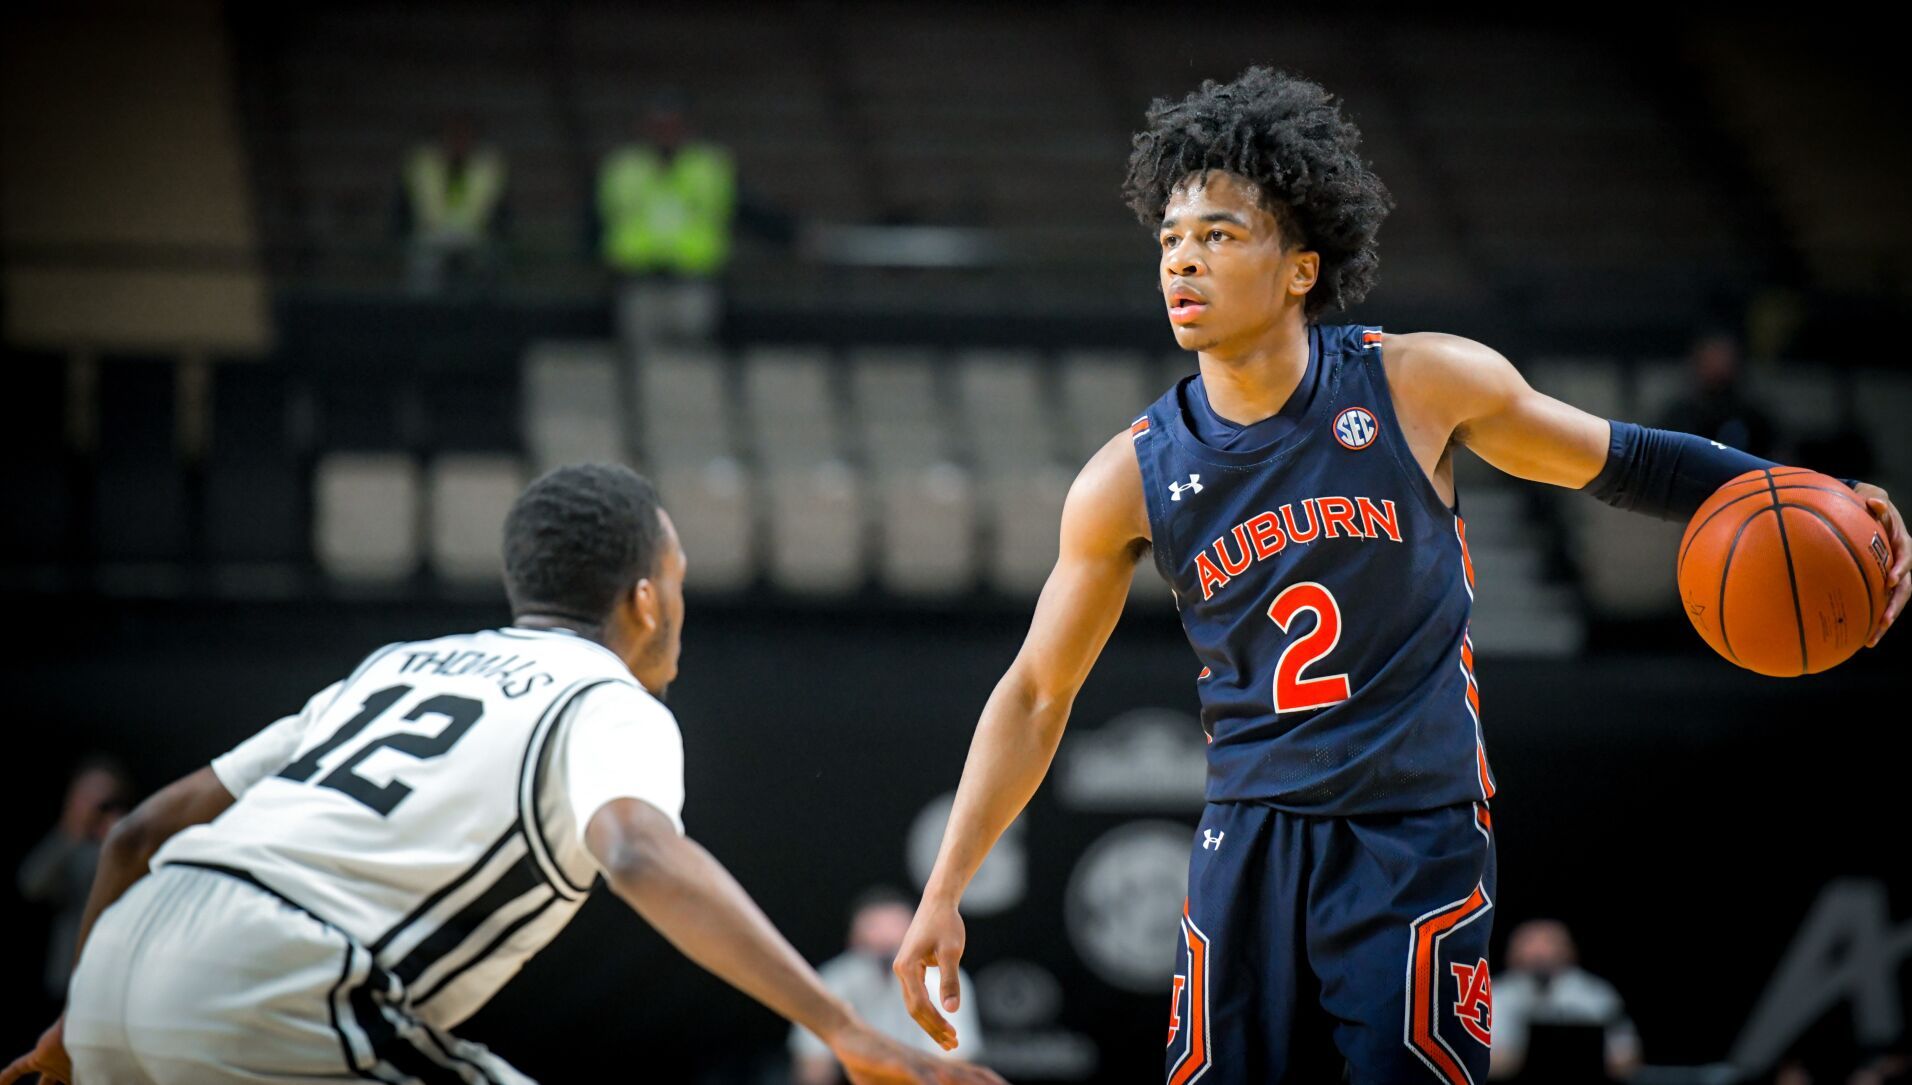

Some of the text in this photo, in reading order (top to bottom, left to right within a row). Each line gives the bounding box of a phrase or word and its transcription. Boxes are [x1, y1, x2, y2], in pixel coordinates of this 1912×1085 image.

[1336, 410, 1375, 447] SEC
[1193, 496, 1403, 601] AUBURN
[398, 650, 555, 699] THOMAS
[1267, 581, 1351, 714] 2
[277, 684, 484, 818] 12
